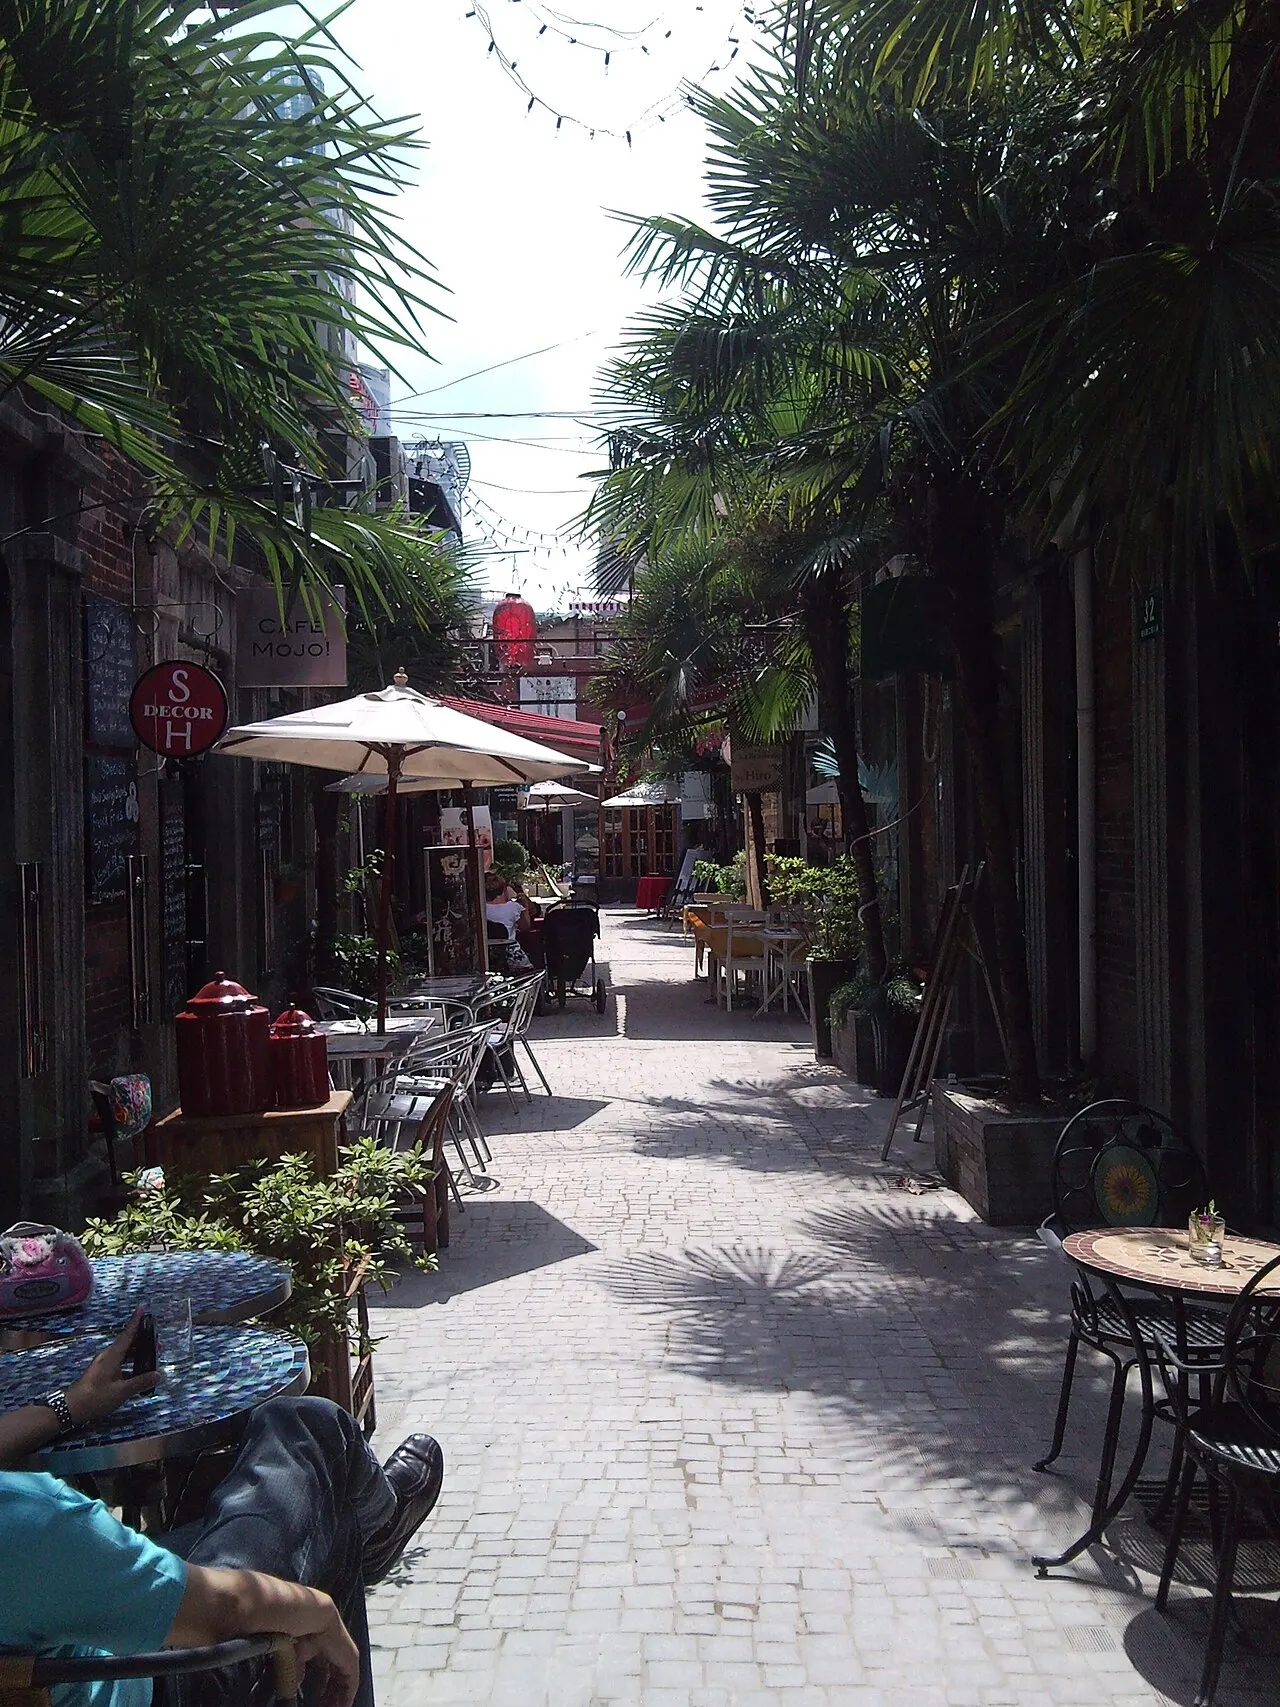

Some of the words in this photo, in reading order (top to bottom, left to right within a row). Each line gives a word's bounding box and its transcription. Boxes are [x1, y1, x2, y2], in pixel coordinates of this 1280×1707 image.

[1143, 596, 1155, 623] 32
[252, 641, 331, 657] MOJO!
[168, 669, 190, 702] S
[143, 704, 213, 720] DECOR
[165, 720, 192, 750] H
[745, 769, 772, 781] Hiro
